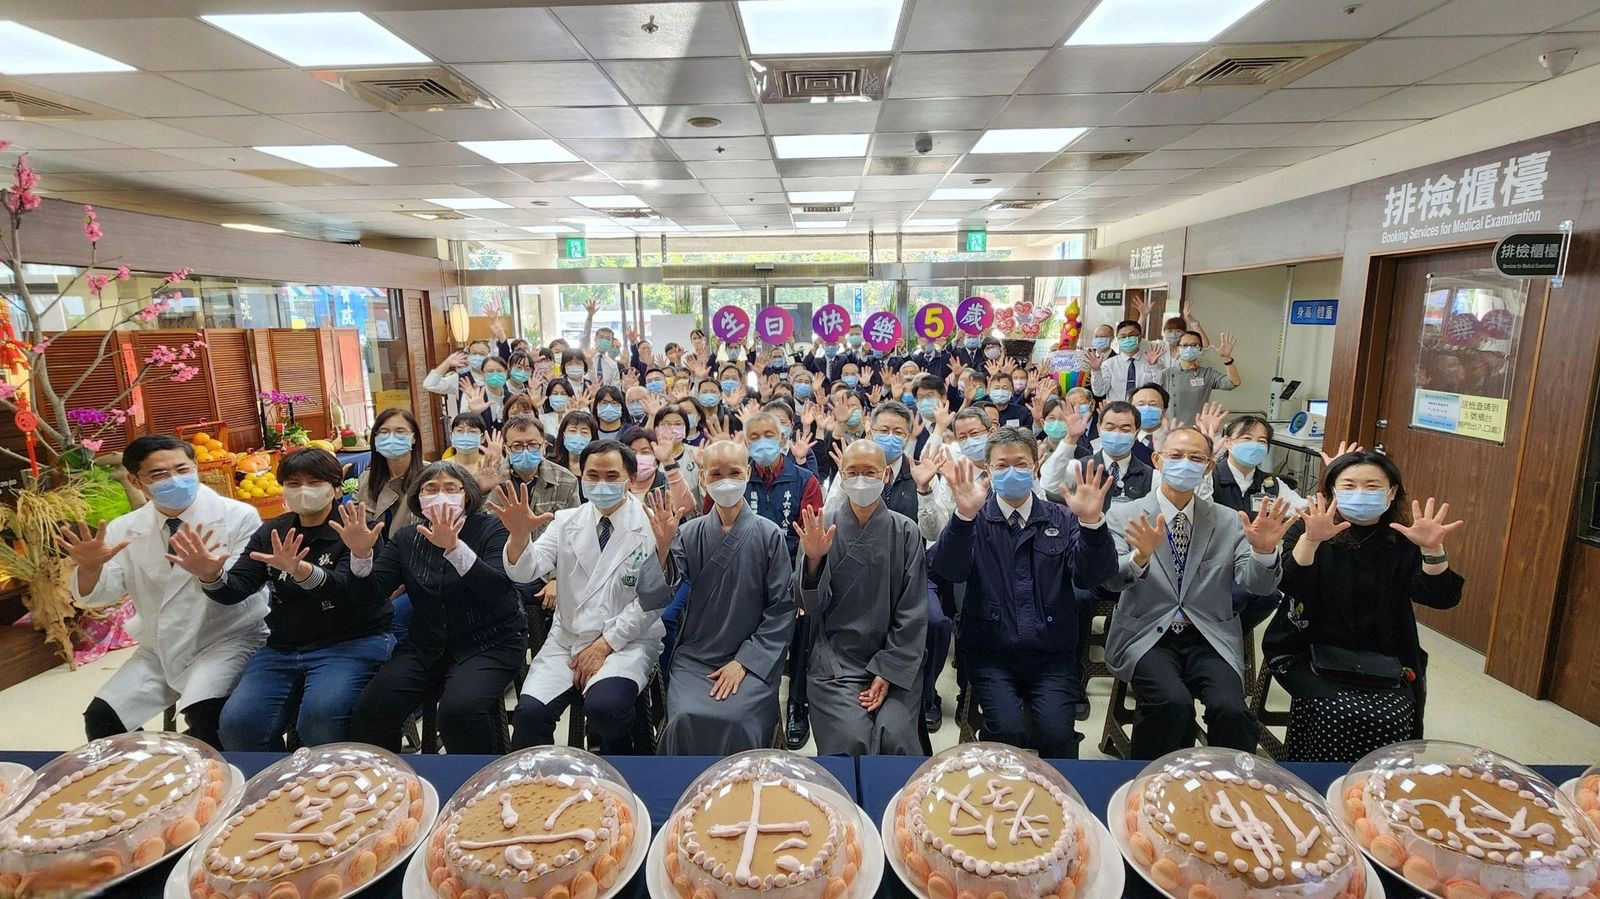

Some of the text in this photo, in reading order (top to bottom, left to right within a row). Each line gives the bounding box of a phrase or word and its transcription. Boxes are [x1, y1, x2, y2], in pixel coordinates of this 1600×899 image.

[1382, 150, 1552, 228] 排檢櫃檯
[1381, 208, 1541, 245] Booking Services for Medical Examination
[1129, 243, 1164, 271] 社服室
[720, 309, 745, 338] 生
[765, 315, 785, 337] 日
[818, 308, 843, 335] 快
[871, 317, 894, 345] 樂
[923, 306, 945, 336] 5
[961, 303, 985, 331] 歲
